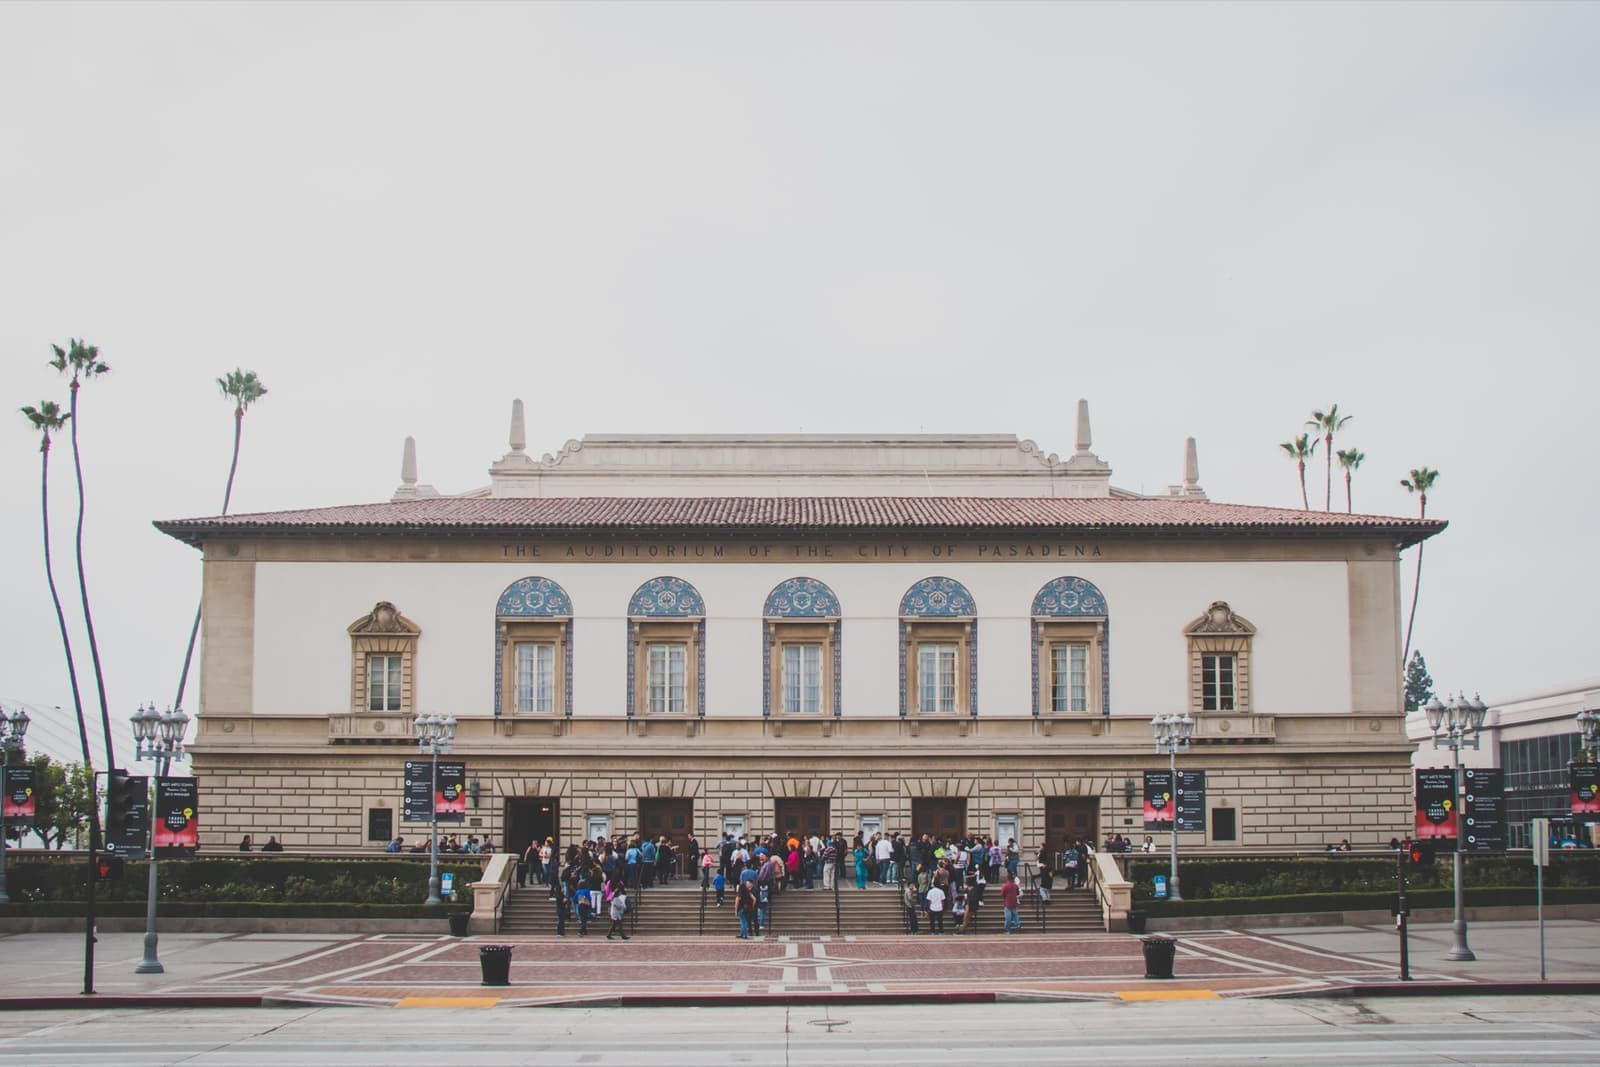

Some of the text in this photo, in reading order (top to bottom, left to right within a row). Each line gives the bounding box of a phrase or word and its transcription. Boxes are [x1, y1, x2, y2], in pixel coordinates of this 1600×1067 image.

[502, 545, 1103, 557] THE AUDITORIUM OF THE CITY OF PASADENA
